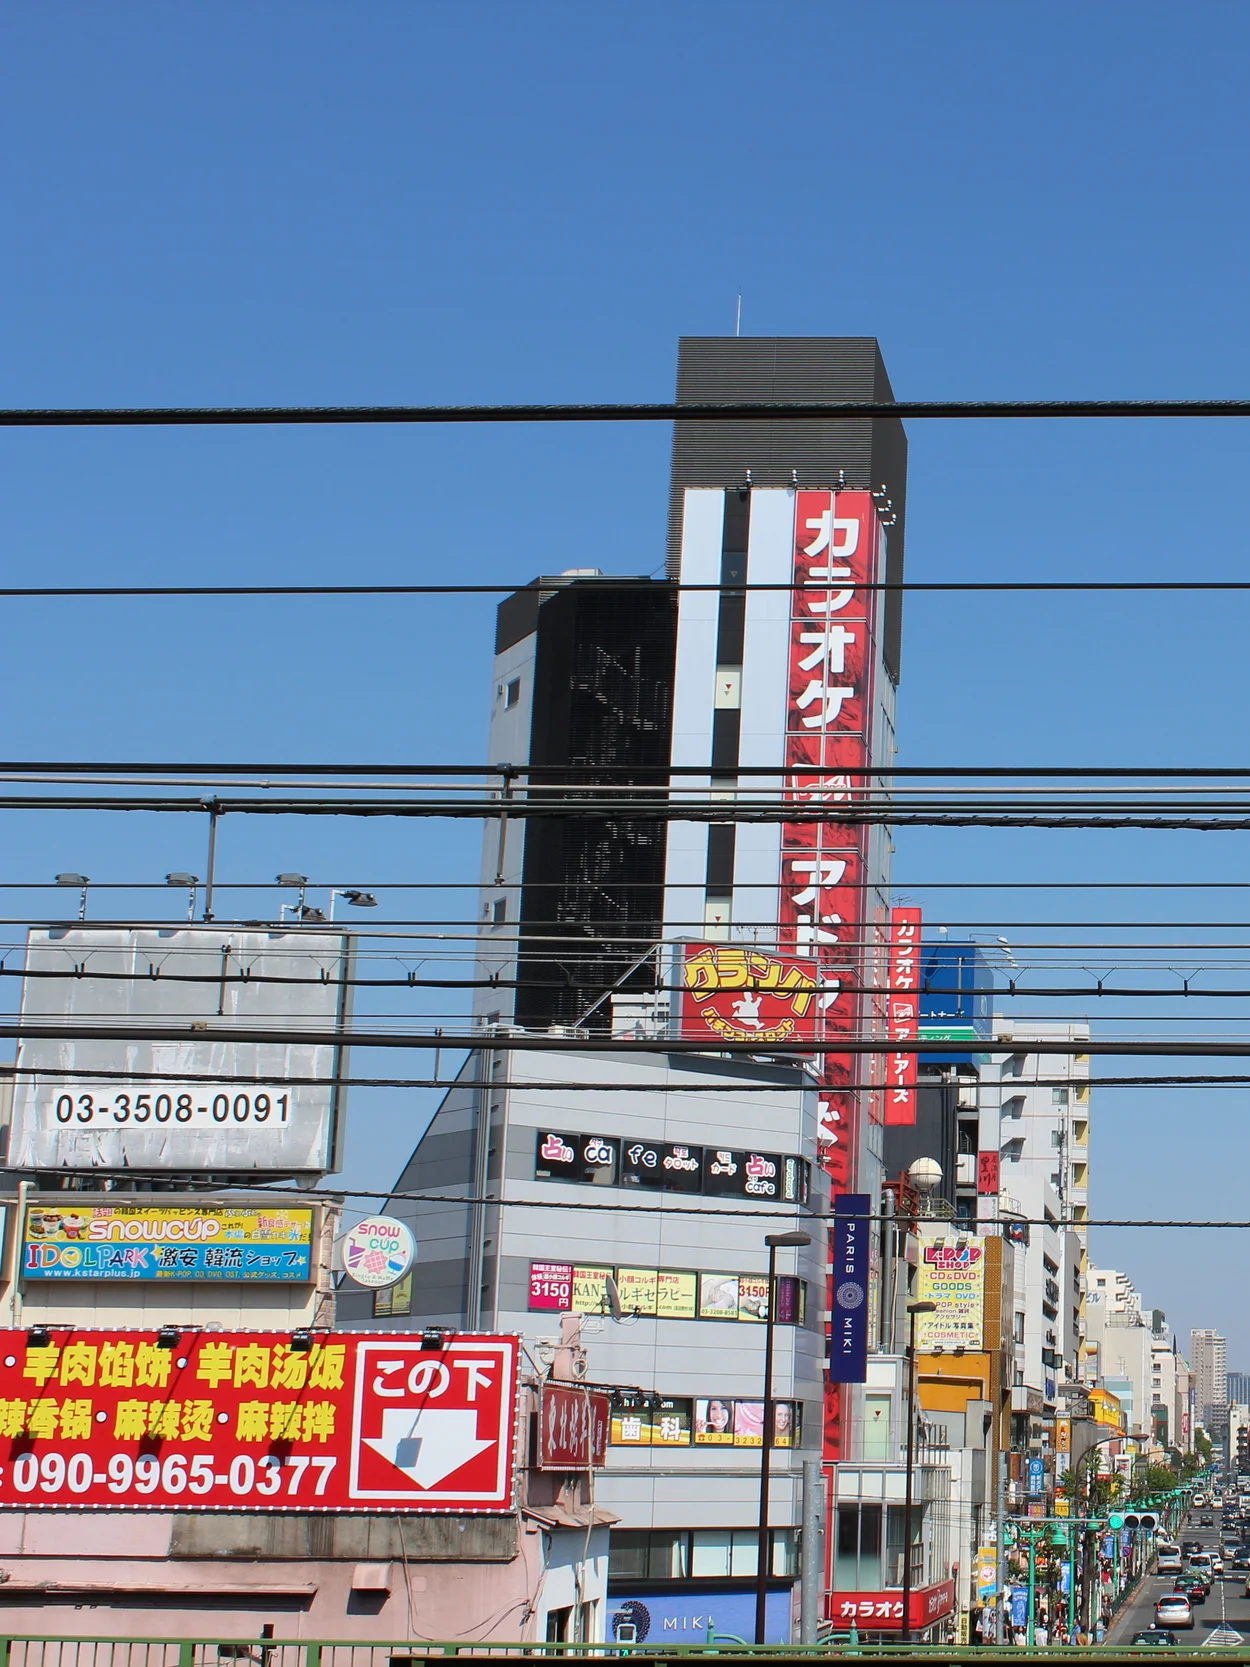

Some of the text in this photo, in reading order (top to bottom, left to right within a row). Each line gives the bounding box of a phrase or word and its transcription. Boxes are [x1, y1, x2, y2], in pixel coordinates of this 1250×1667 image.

[794, 509, 861, 730] カラオケ
[895, 919, 915, 991] カラオケ
[892, 1028, 915, 1104] アアーズ
[56, 1093, 288, 1123] 03-3508-0091
[542, 1134, 575, 1163] 占い
[710, 1162, 738, 1176] カード
[746, 1154, 776, 1178] 占い
[745, 1181, 775, 1195] cafe
[358, 1223, 401, 1238] snow
[158, 1247, 199, 1268] 激安
[369, 1238, 400, 1254] cup
[845, 1222, 856, 1274] PARIS
[44, 1269, 141, 1279] www.kstarplus.jp
[531, 1281, 570, 1297] 3150
[932, 1282, 972, 1291] GOODS
[955, 1292, 976, 1300] DVD
[558, 1297, 569, 1307] 円
[954, 1301, 975, 1309] style
[843, 1317, 853, 1354] MIKI
[927, 1331, 975, 1339] COSMETIC
[23, 1340, 346, 1391] 羊肉馅饼 羊肉汤饭
[372, 1359, 496, 1402] この下
[113, 1398, 215, 1443] 麻辣烫
[235, 1399, 337, 1444] 麻辣拌
[621, 1416, 680, 1441] 歯科
[12, 1452, 337, 1496] 090-9965-0377
[841, 1601, 904, 1618] カラオケ
